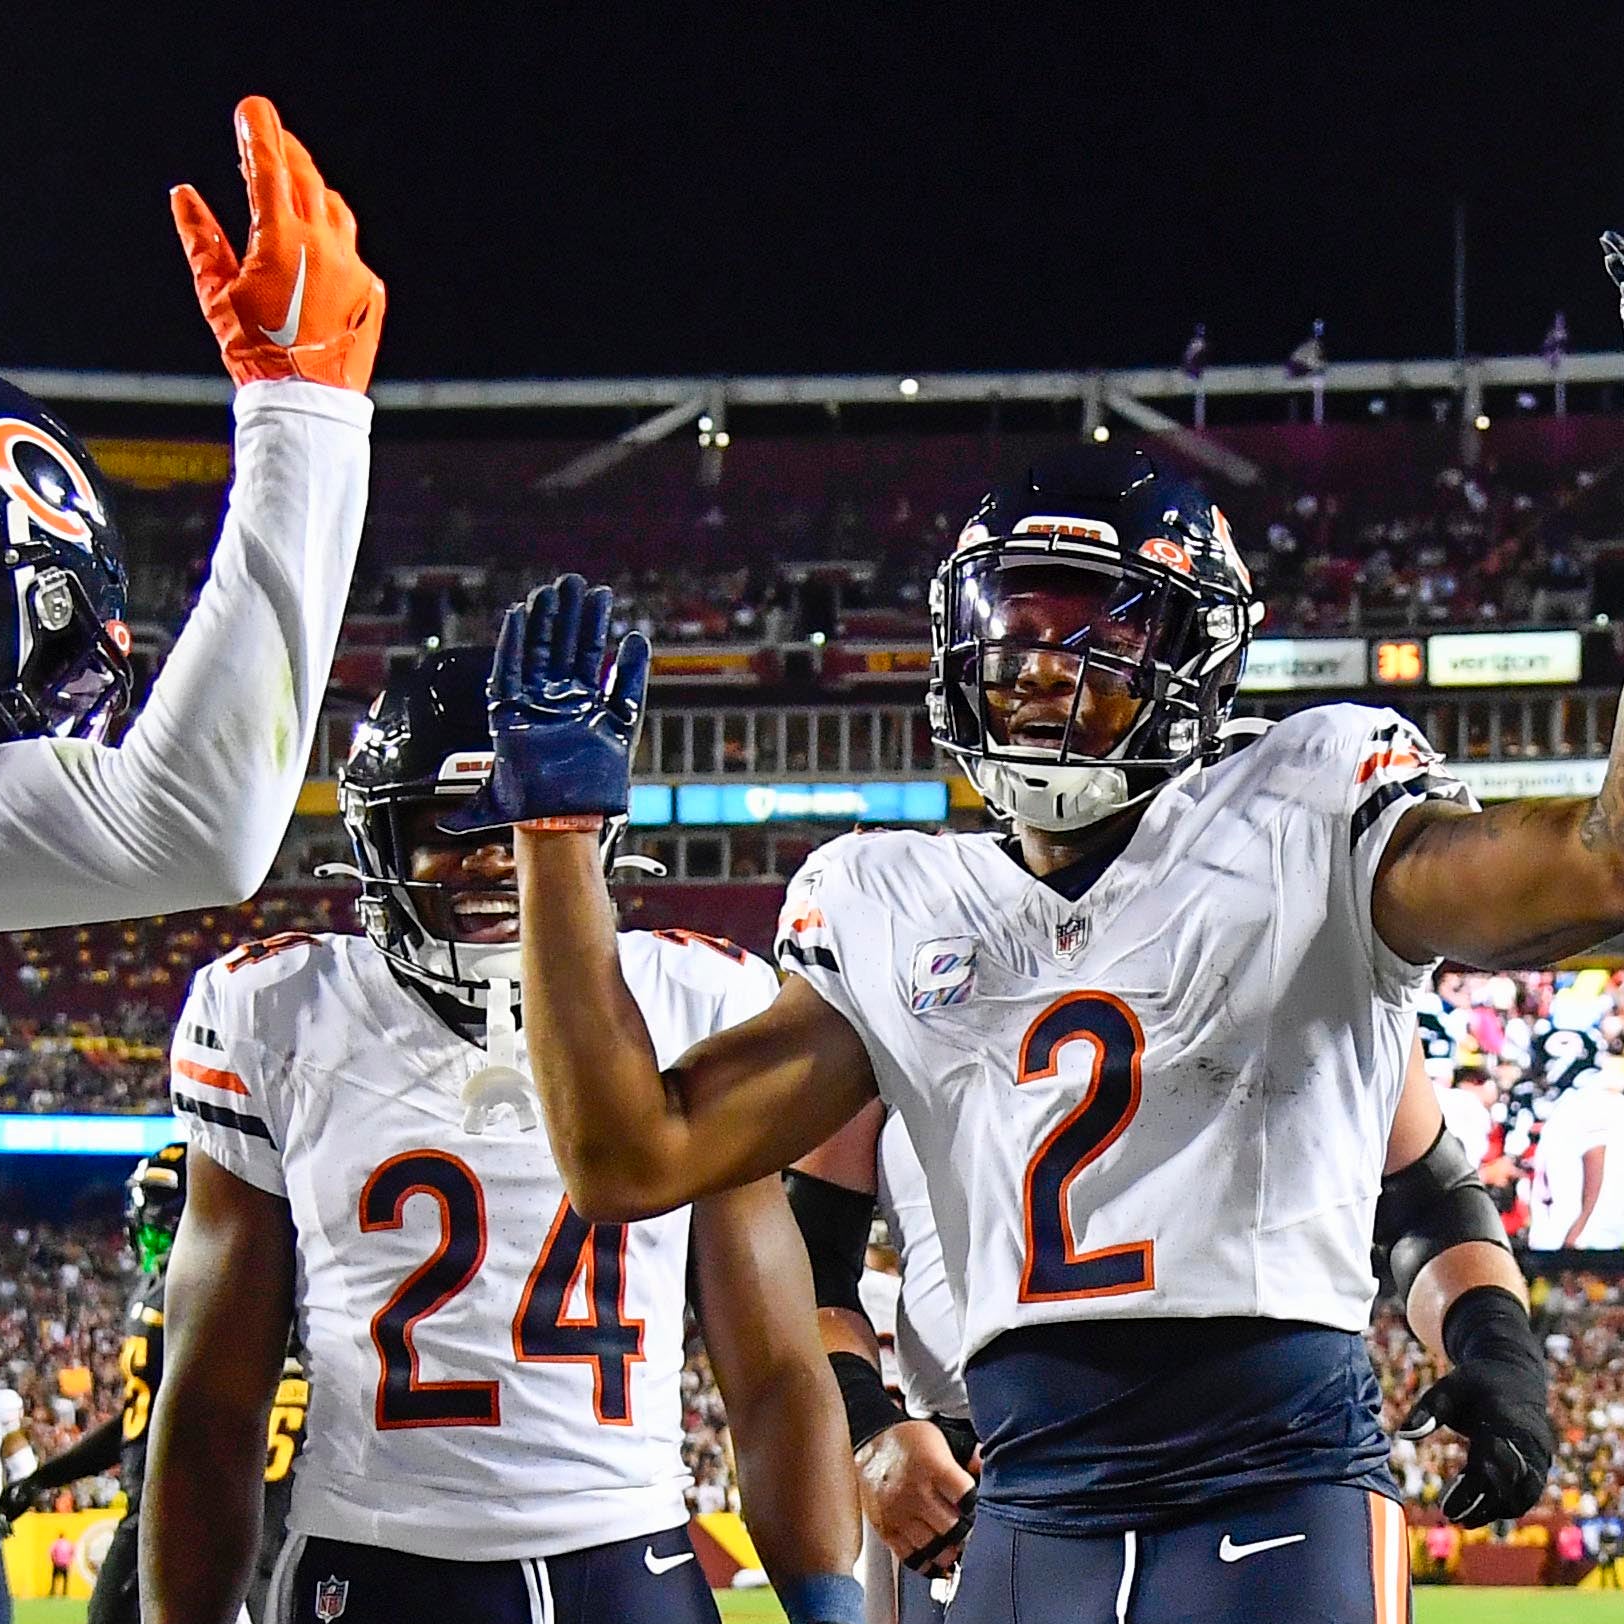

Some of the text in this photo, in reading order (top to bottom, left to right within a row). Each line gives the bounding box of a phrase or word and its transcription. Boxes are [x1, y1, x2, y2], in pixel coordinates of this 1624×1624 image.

[455, 761, 493, 773] BEA
[1059, 935, 1083, 952] NFL
[1016, 989, 1156, 1305] 2
[359, 1148, 648, 1431] 24
